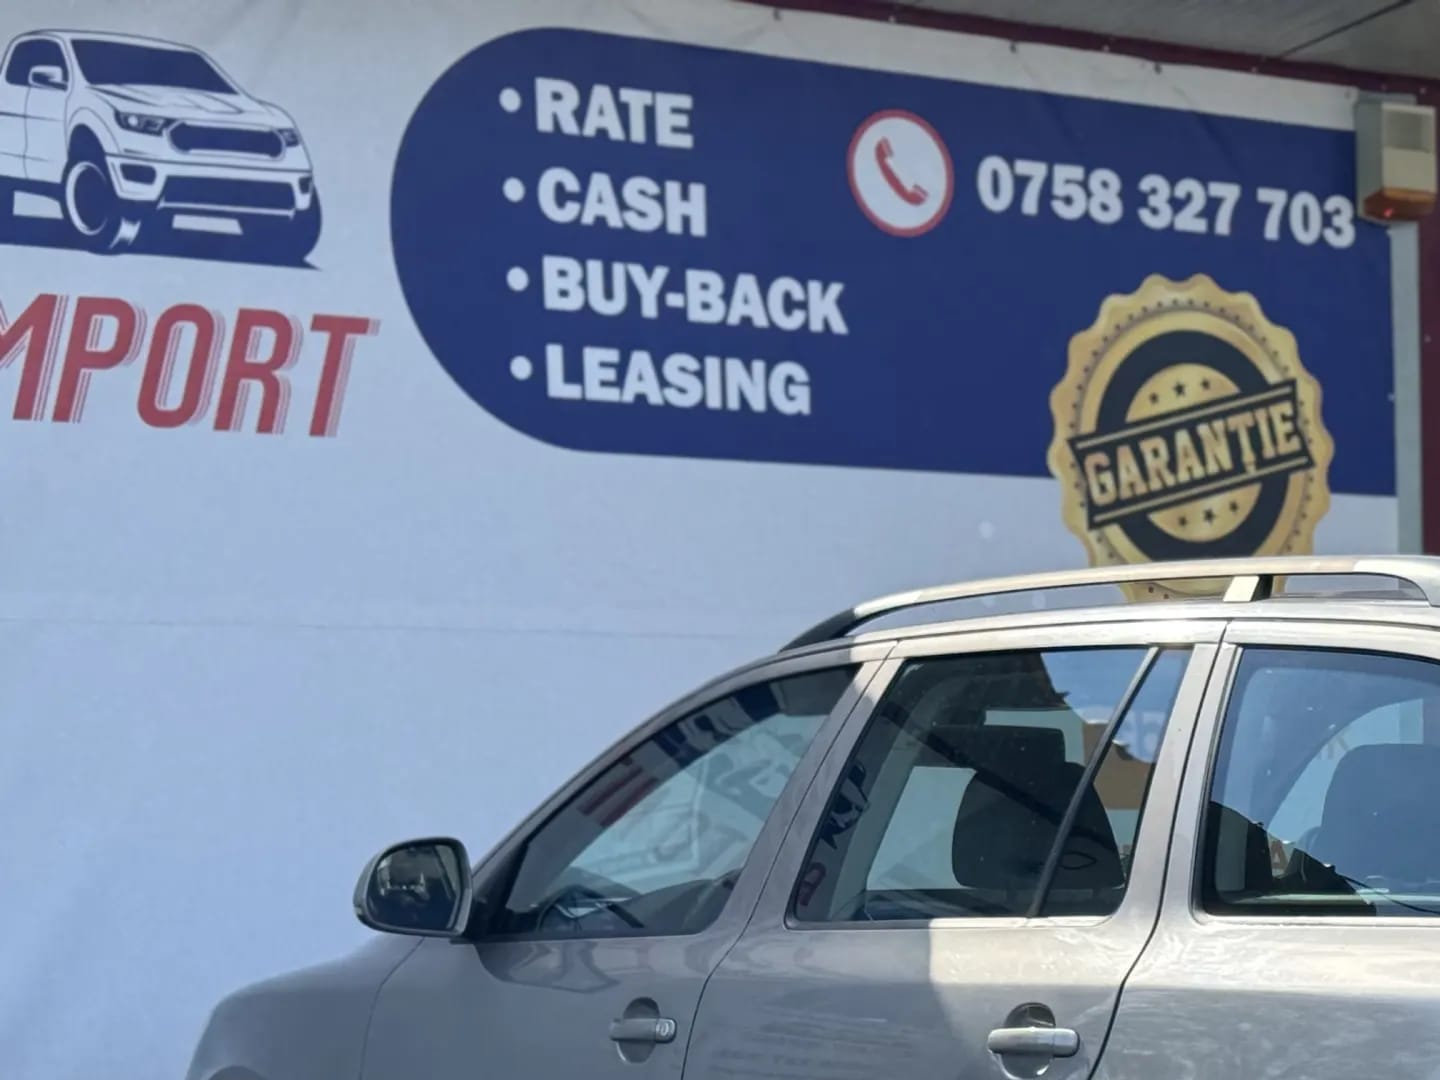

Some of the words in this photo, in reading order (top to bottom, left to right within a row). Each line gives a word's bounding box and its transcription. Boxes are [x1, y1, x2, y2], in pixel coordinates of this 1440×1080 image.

[535, 77, 694, 149] RATE
[537, 166, 707, 237] CASH
[977, 155, 1123, 224] 0758
[1137, 174, 1241, 236] 327
[1256, 187, 1355, 248] 703
[543, 255, 849, 335] BUY-BACK
[546, 343, 811, 416] LEASING
